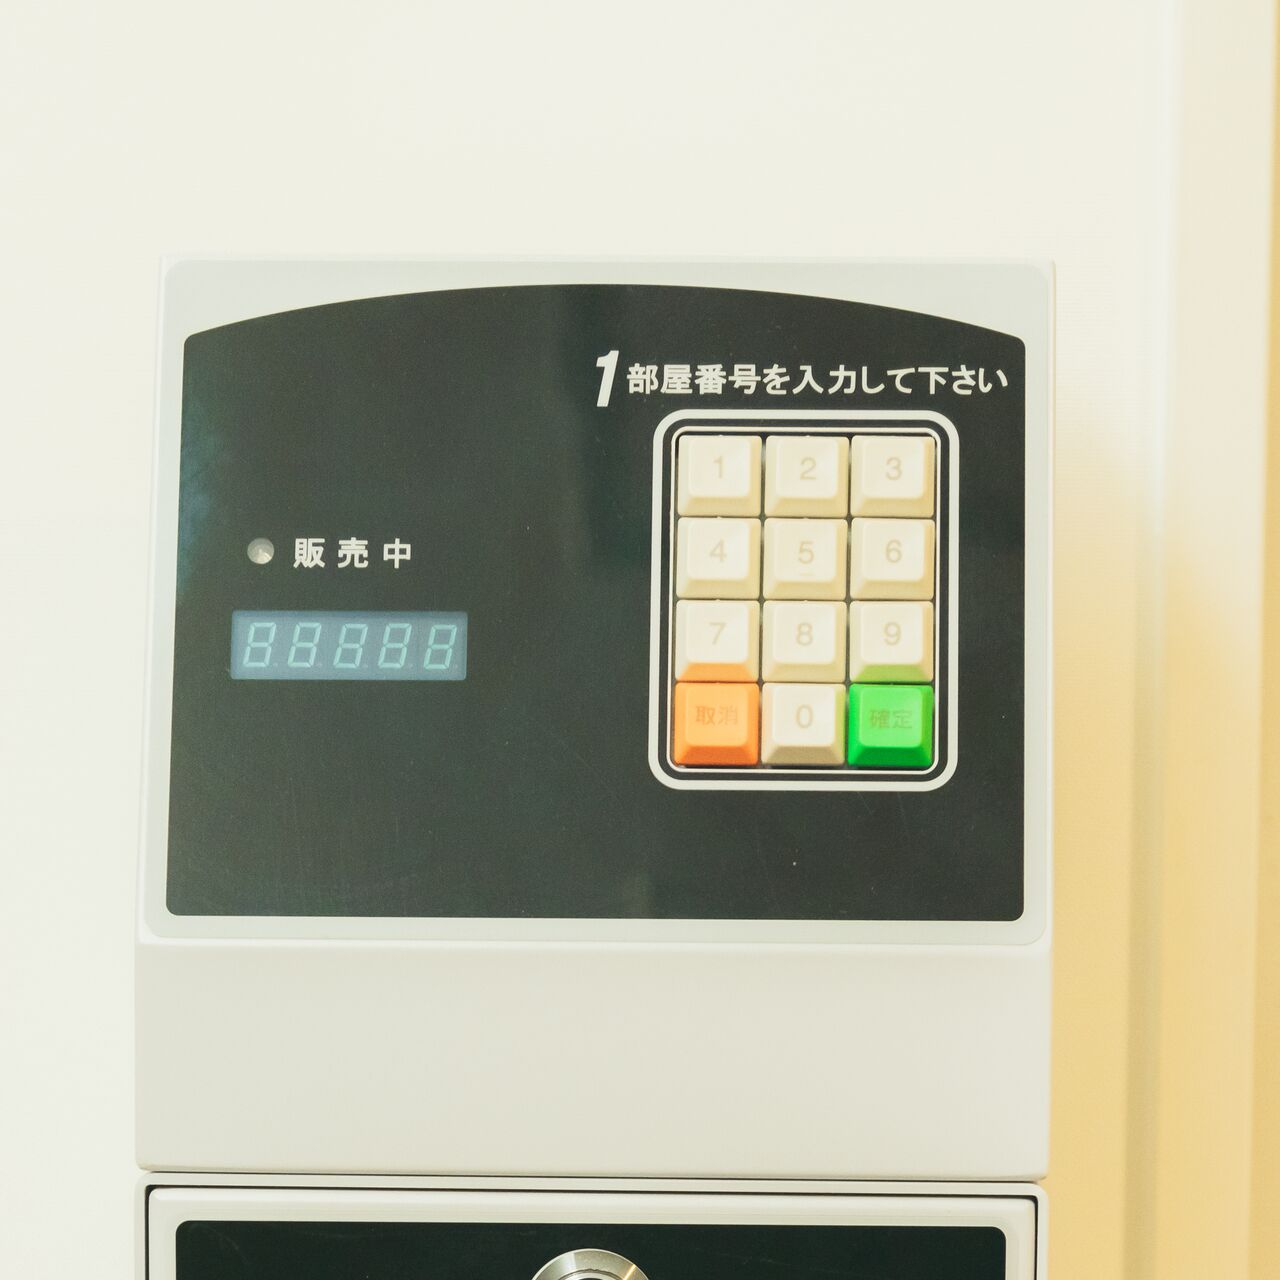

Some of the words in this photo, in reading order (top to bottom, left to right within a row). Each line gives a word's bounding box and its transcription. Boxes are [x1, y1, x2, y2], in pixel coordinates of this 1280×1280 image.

[595, 350, 620, 408] 1
[626, 362, 1008, 395] 部屋番号を入力して下さい
[711, 456, 725, 480] 1
[799, 456, 817, 481] 2
[885, 456, 902, 481] 3
[293, 536, 412, 569] 販売中
[709, 540, 727, 563] 4
[798, 541, 815, 565] 5
[885, 539, 902, 564] 6
[709, 622, 726, 645] 7
[796, 622, 813, 646] 8
[884, 622, 901, 646] 9
[695, 705, 739, 727] 取消
[796, 705, 813, 729] 0
